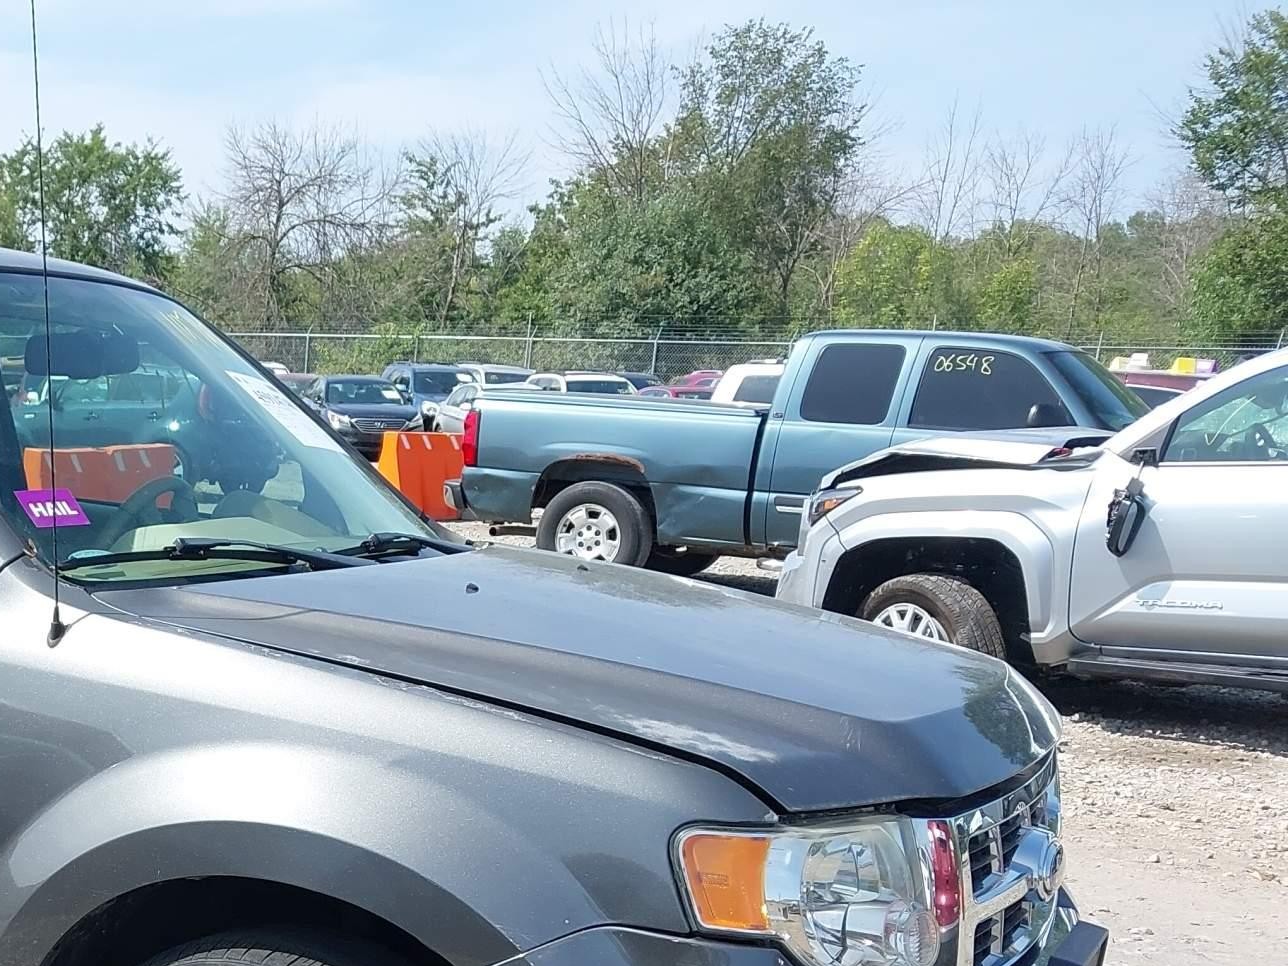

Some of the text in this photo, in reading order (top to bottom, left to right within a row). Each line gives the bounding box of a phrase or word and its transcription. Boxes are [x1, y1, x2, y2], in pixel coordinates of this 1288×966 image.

[934, 354, 995, 375] 06548
[28, 501, 79, 518] HAIL
[1135, 599, 1224, 610] TACOMA
